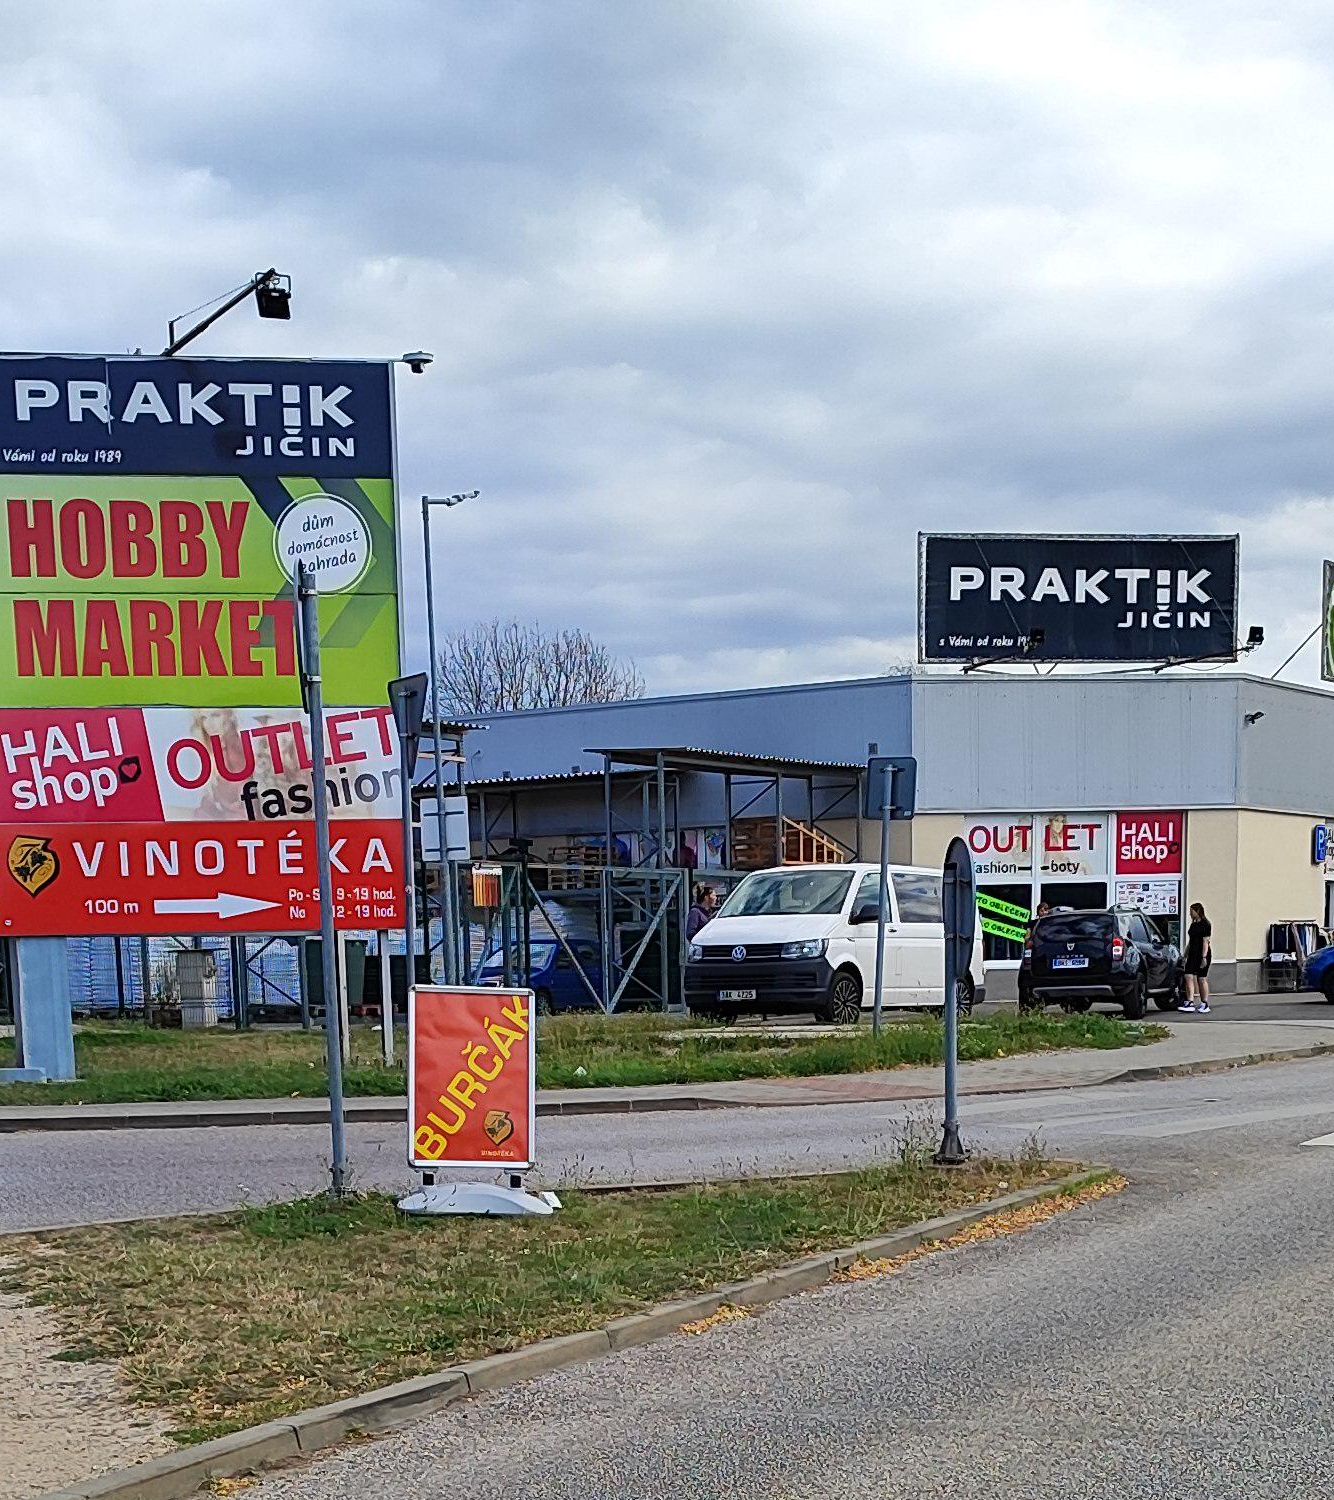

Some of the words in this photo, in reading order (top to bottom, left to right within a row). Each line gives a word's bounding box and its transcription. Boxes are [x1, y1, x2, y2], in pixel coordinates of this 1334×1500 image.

[15, 379, 355, 428] PRAKTIK
[2, 448, 35, 462] Vámi
[40, 448, 56, 462] od
[61, 448, 89, 463] roku
[94, 449, 122, 463] 1989
[302, 514, 334, 533] dům
[6, 498, 250, 579] HOBBY
[287, 528, 359, 556] domácnost
[950, 565, 1214, 605] PRAKTIK
[12, 599, 298, 677] MARKET
[977, 635, 989, 646] od
[992, 635, 1014, 646] roku
[0, 716, 125, 774] HALI
[166, 706, 395, 790] OUTLET
[12, 755, 119, 811] shop
[968, 824, 1103, 853] OUTLET
[1120, 822, 1174, 843] HALI
[72, 829, 395, 878] VINOTÉKA
[1120, 835, 1168, 863] shop
[972, 860, 1017, 874] ashion
[1050, 860, 1080, 874] boty
[84, 899, 119, 914] 100
[123, 901, 140, 914] m
[288, 888, 304, 901] Po
[336, 887, 345, 901] 9
[353, 887, 369, 901] 19
[372, 886, 396, 901] hod.
[354, 904, 370, 918] 19
[373, 904, 397, 918] hod.
[414, 995, 529, 1161] BURČÁK
